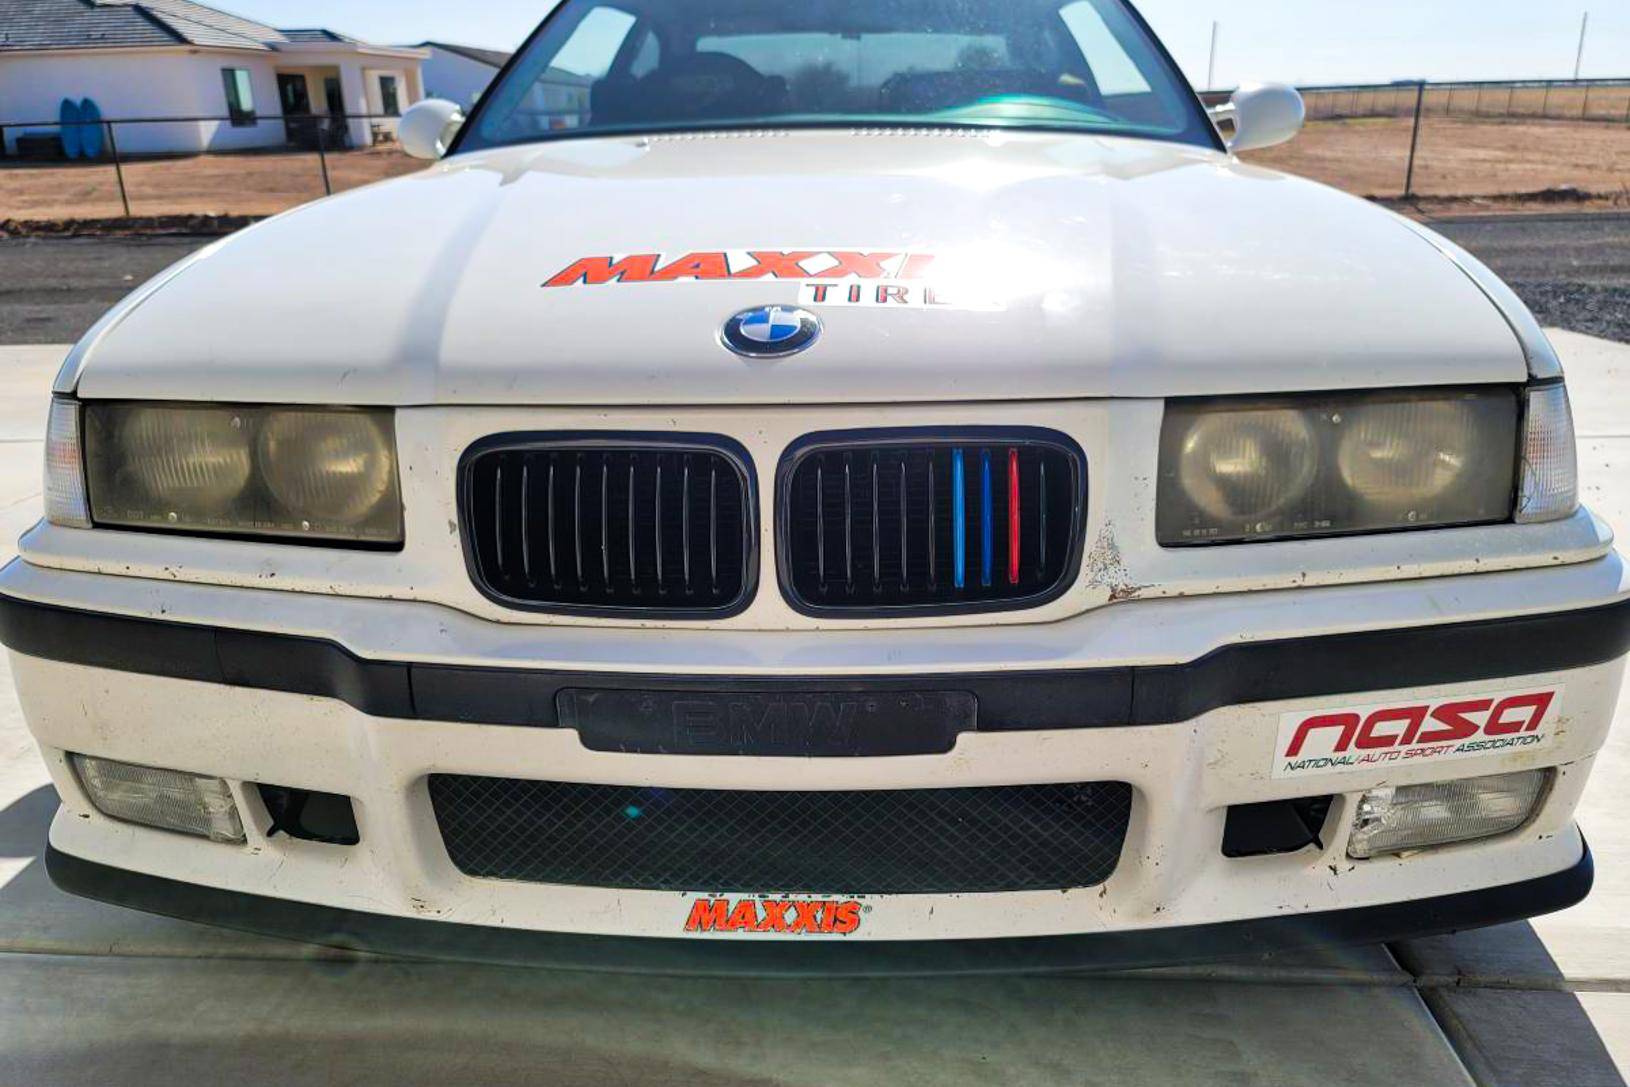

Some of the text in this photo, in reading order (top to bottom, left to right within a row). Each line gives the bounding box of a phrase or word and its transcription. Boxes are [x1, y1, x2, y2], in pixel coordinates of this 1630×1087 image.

[541, 251, 936, 287] MAXXI
[805, 283, 953, 305] TIR
[671, 700, 859, 746] BMW
[1283, 755, 1354, 772] NATIONAL
[1401, 744, 1454, 760] SPORT
[1454, 734, 1545, 753] ASSOCIATION
